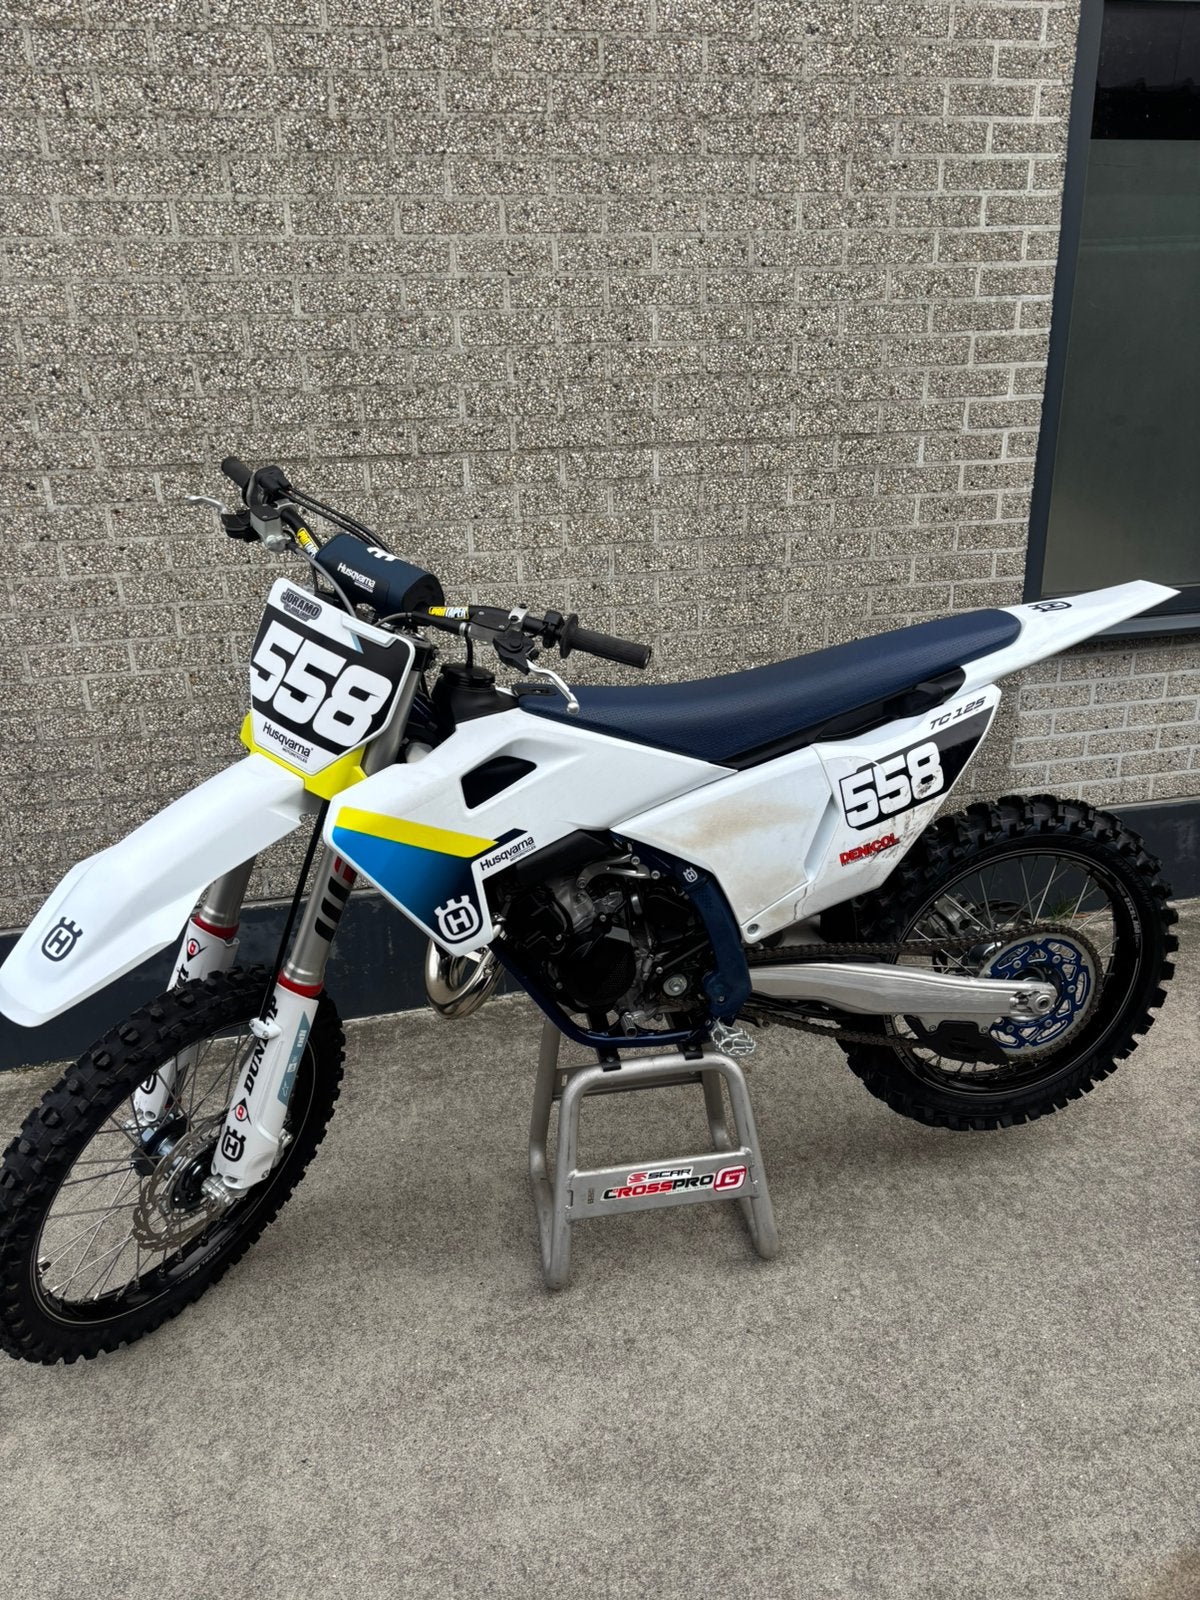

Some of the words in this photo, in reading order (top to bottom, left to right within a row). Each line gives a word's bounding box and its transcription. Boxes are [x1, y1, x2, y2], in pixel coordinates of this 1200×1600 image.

[337, 562, 376, 587] Husqvarna
[282, 591, 320, 617] JORAMO
[250, 620, 393, 747] 558
[930, 712, 952, 730] TC
[953, 696, 987, 720] 125
[262, 721, 314, 757] Husqvarna
[839, 741, 945, 828] 558
[480, 837, 534, 871] Husqvarna
[839, 833, 900, 865] DENICOL
[603, 1174, 713, 1200] CROSSPRO
[648, 1168, 692, 1180] SCAR
